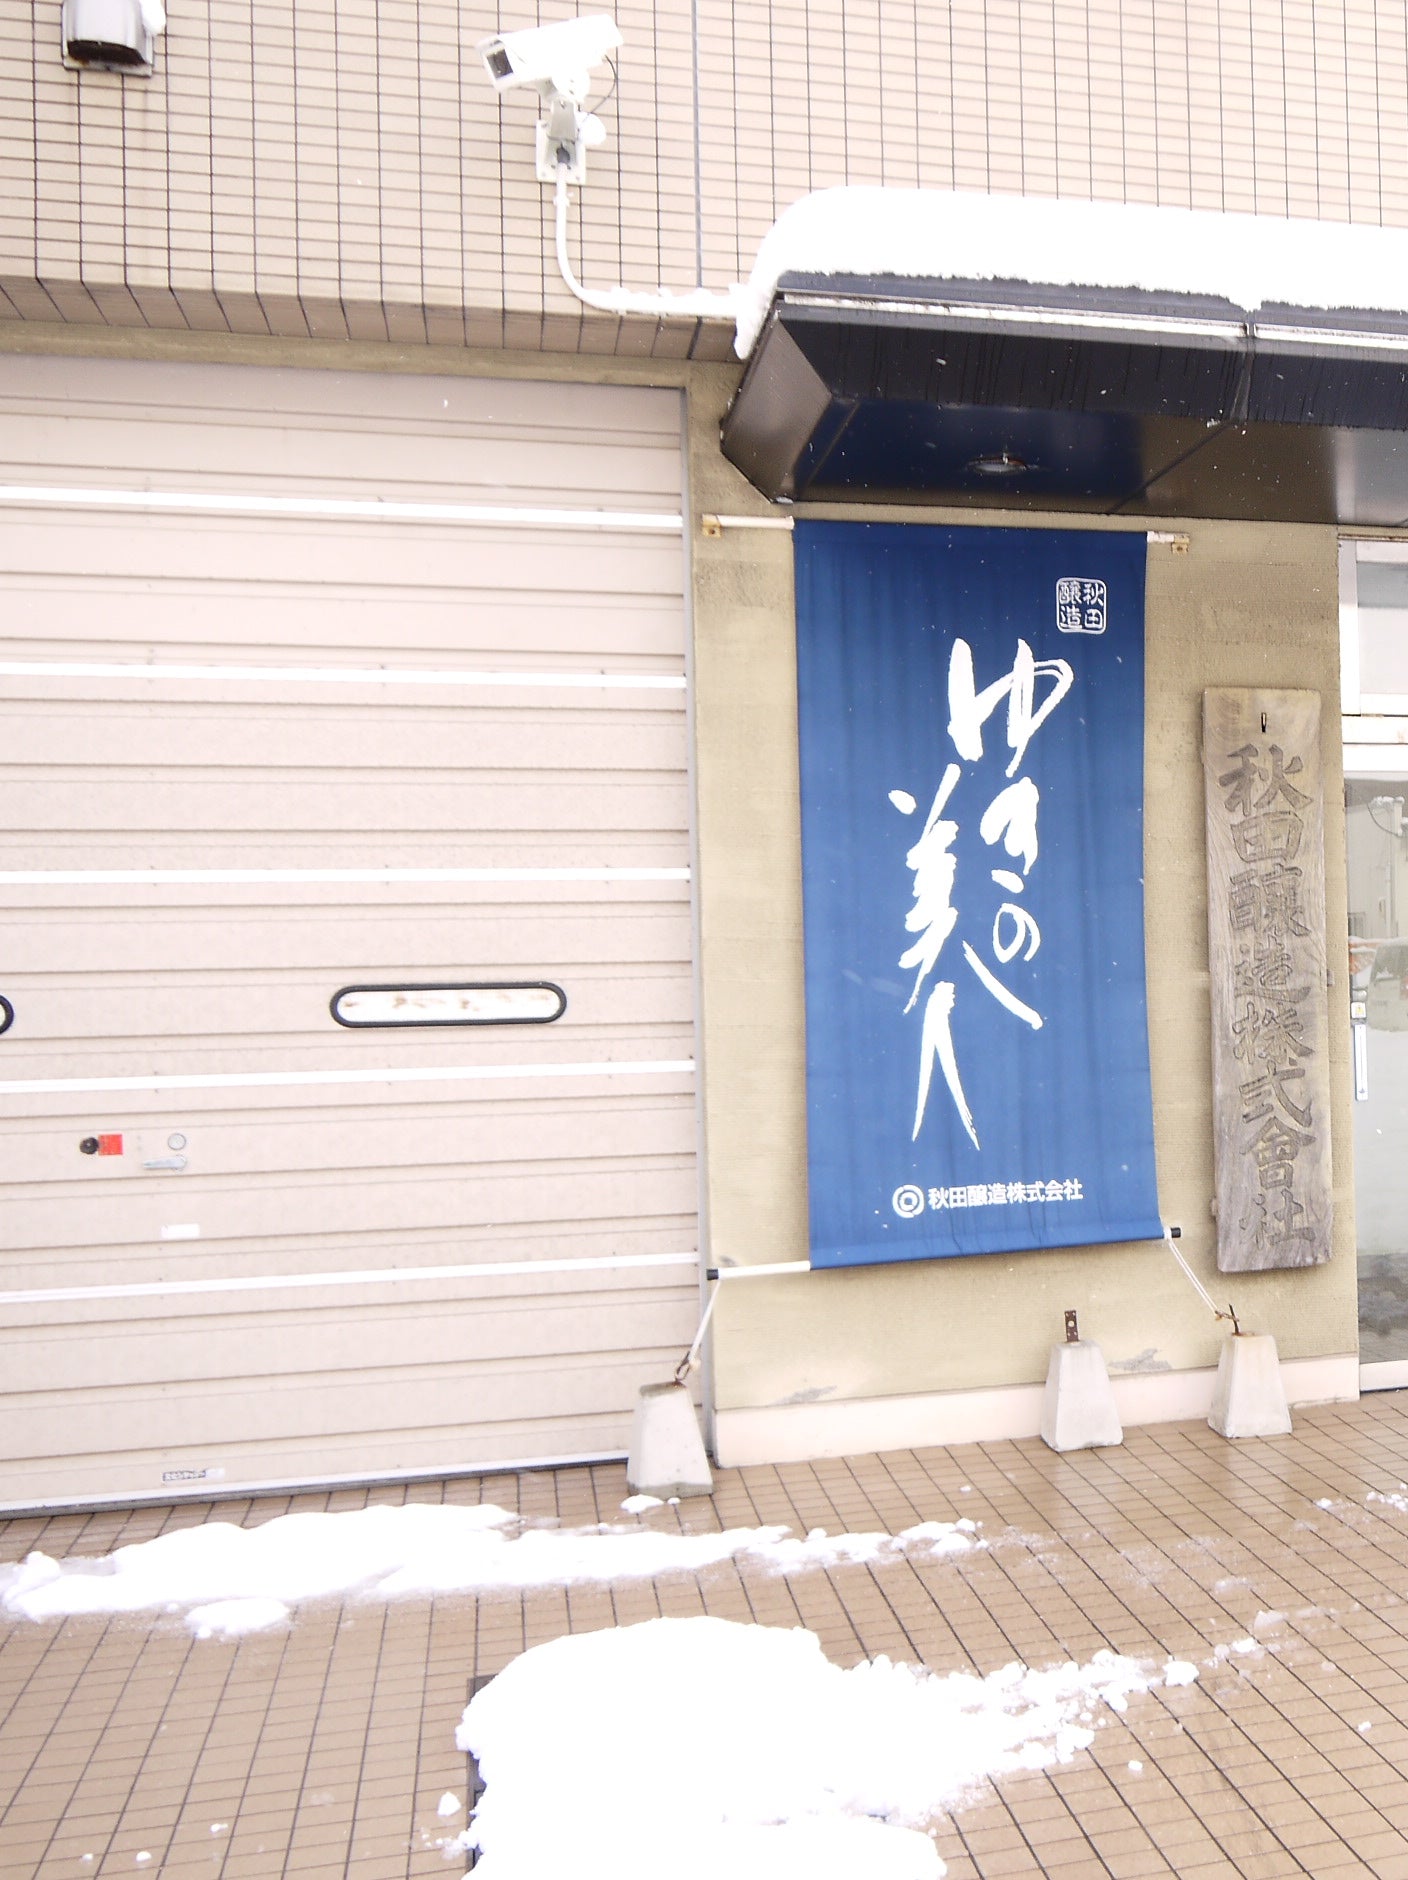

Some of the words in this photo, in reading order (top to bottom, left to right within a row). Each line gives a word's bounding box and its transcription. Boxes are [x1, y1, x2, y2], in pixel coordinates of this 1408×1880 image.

[928, 1178, 1084, 1210] 秋田醸造株式会社
